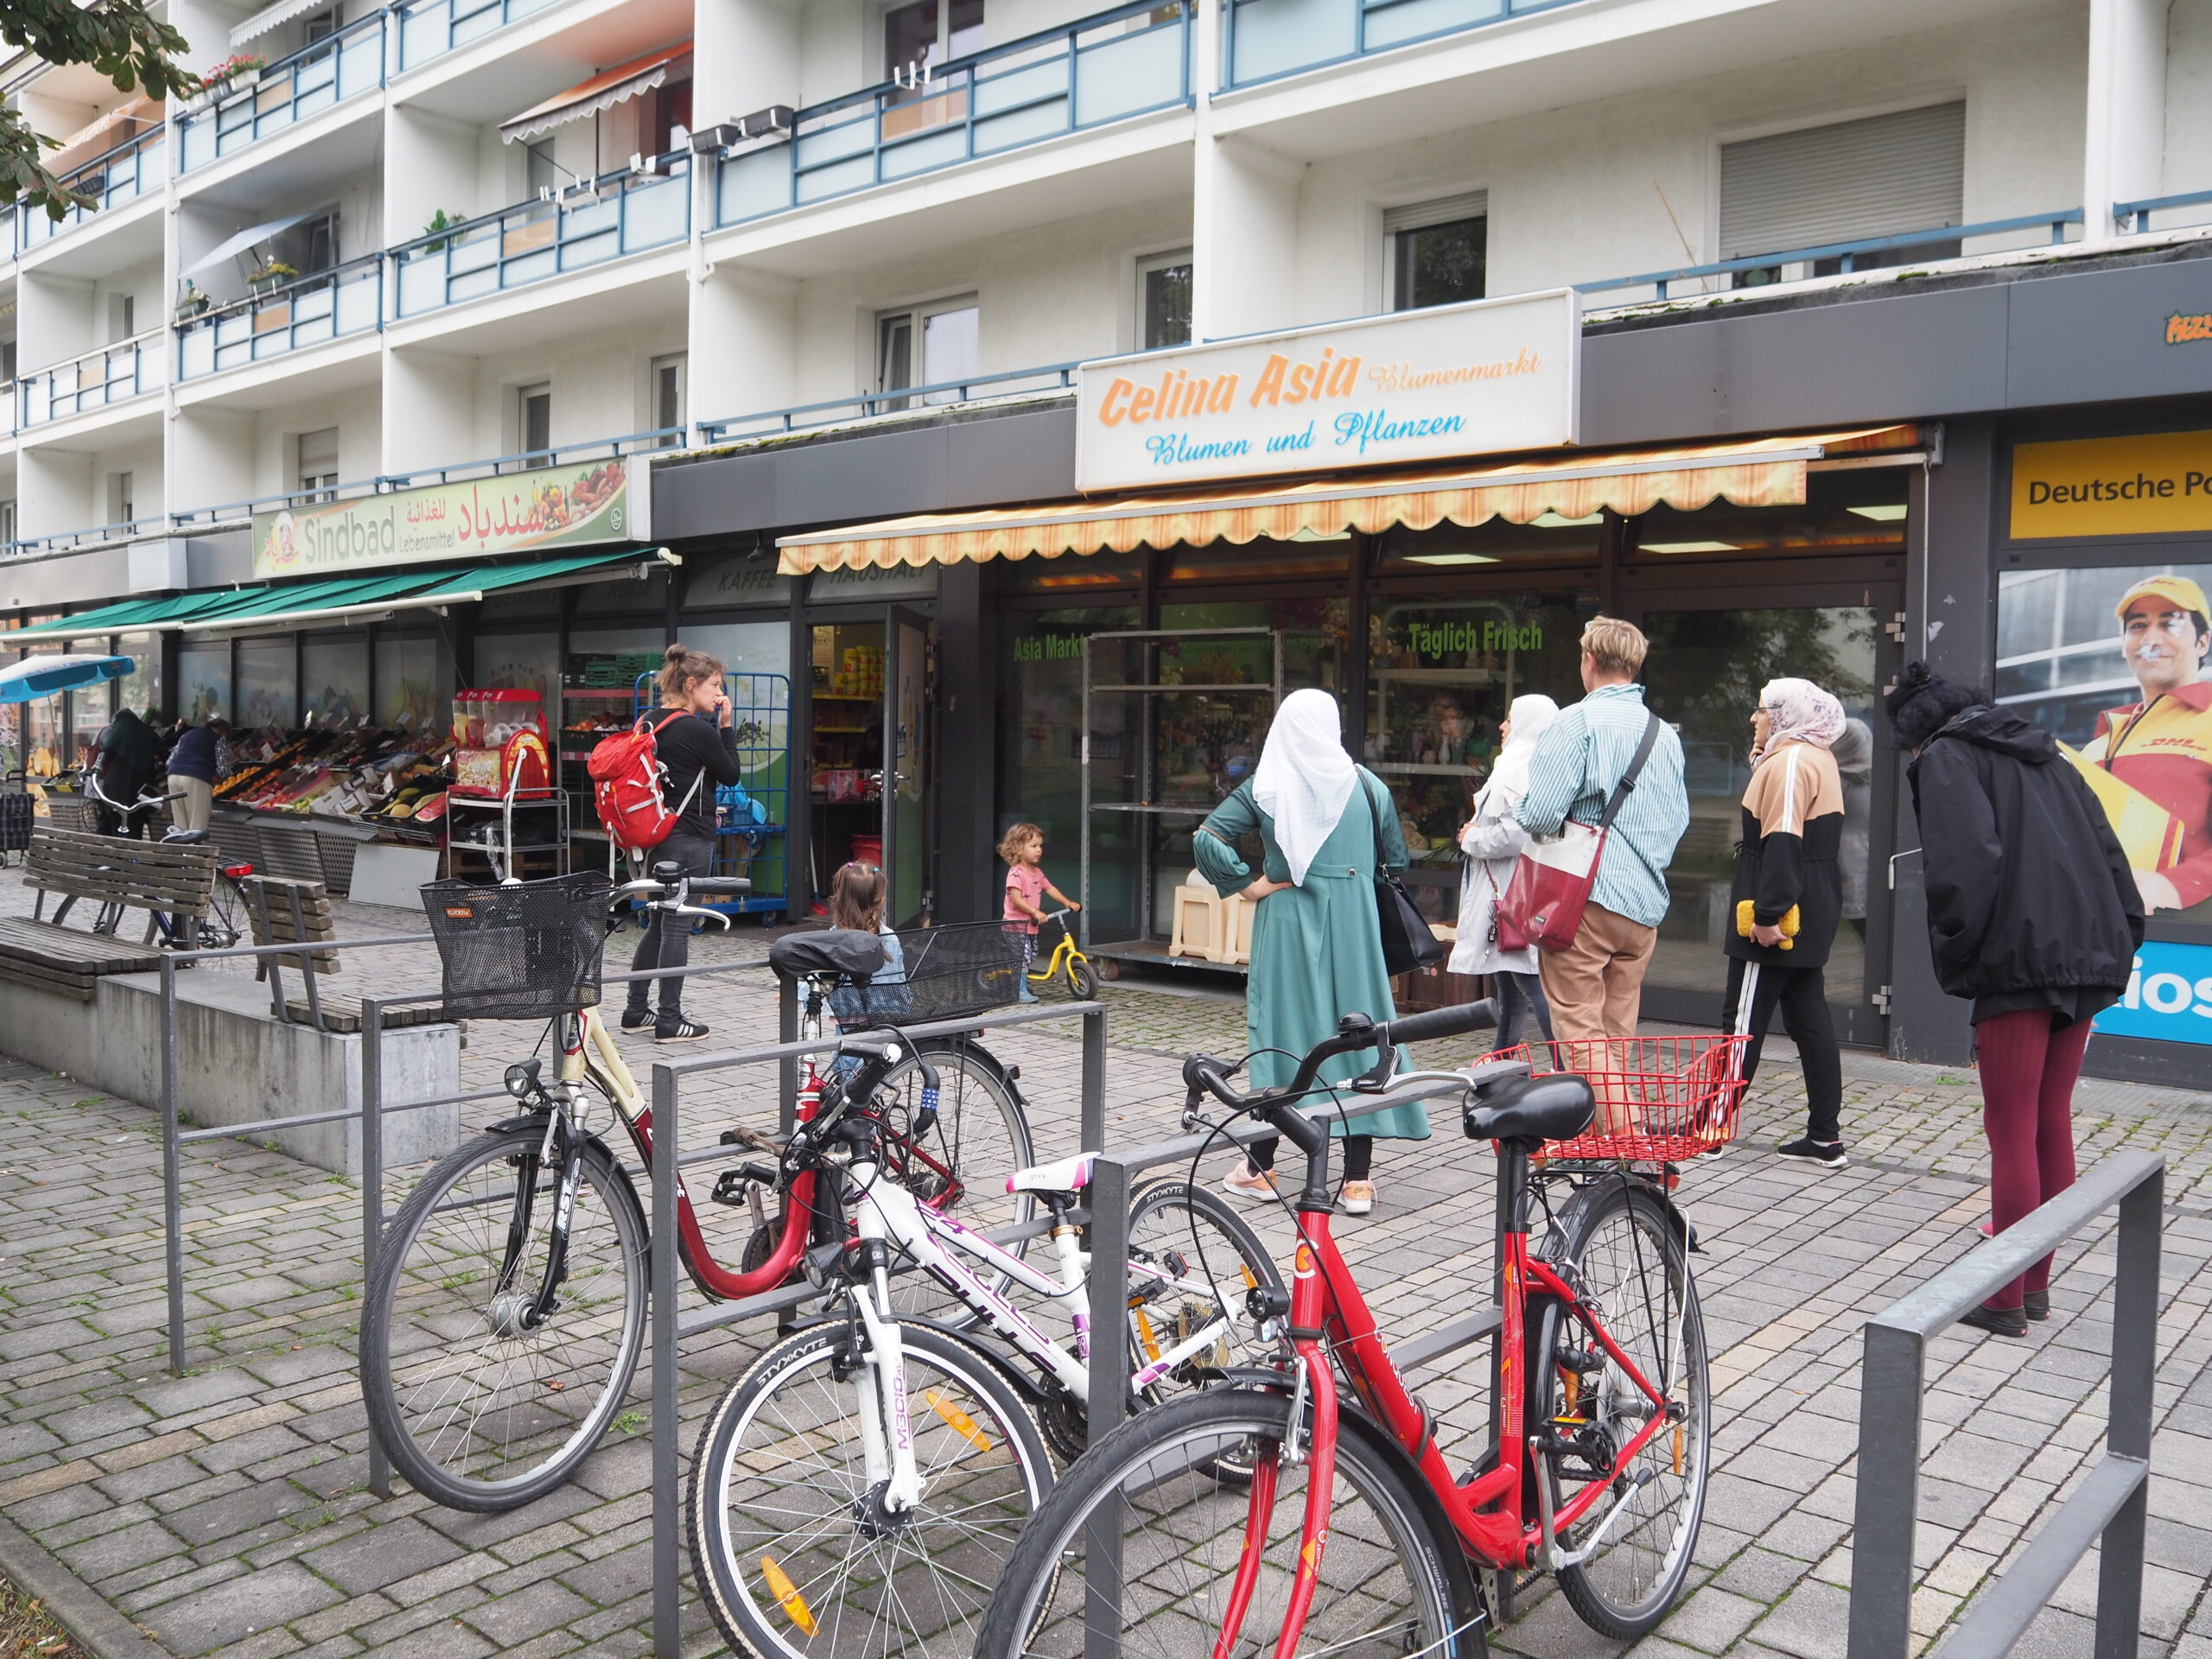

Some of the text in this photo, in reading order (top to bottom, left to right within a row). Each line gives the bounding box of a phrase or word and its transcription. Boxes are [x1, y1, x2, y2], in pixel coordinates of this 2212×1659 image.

[1098, 346, 1363, 427] Celina Asia
[1368, 346, 1542, 393] Blumenmarkt
[1146, 410, 1467, 465] Blumen und Pflanzen
[2030, 474, 2175, 505] Deutsche
[305, 505, 395, 564] Sindbad
[398, 529, 455, 553] Lebensmittel
[717, 569, 778, 592] KAFFEE
[1014, 636, 1042, 662] Asia
[1408, 620, 1542, 660] Täglich Frisch
[555, 1176, 574, 1233] RST
[1424, 1547, 1449, 1610] SCHWALBE
